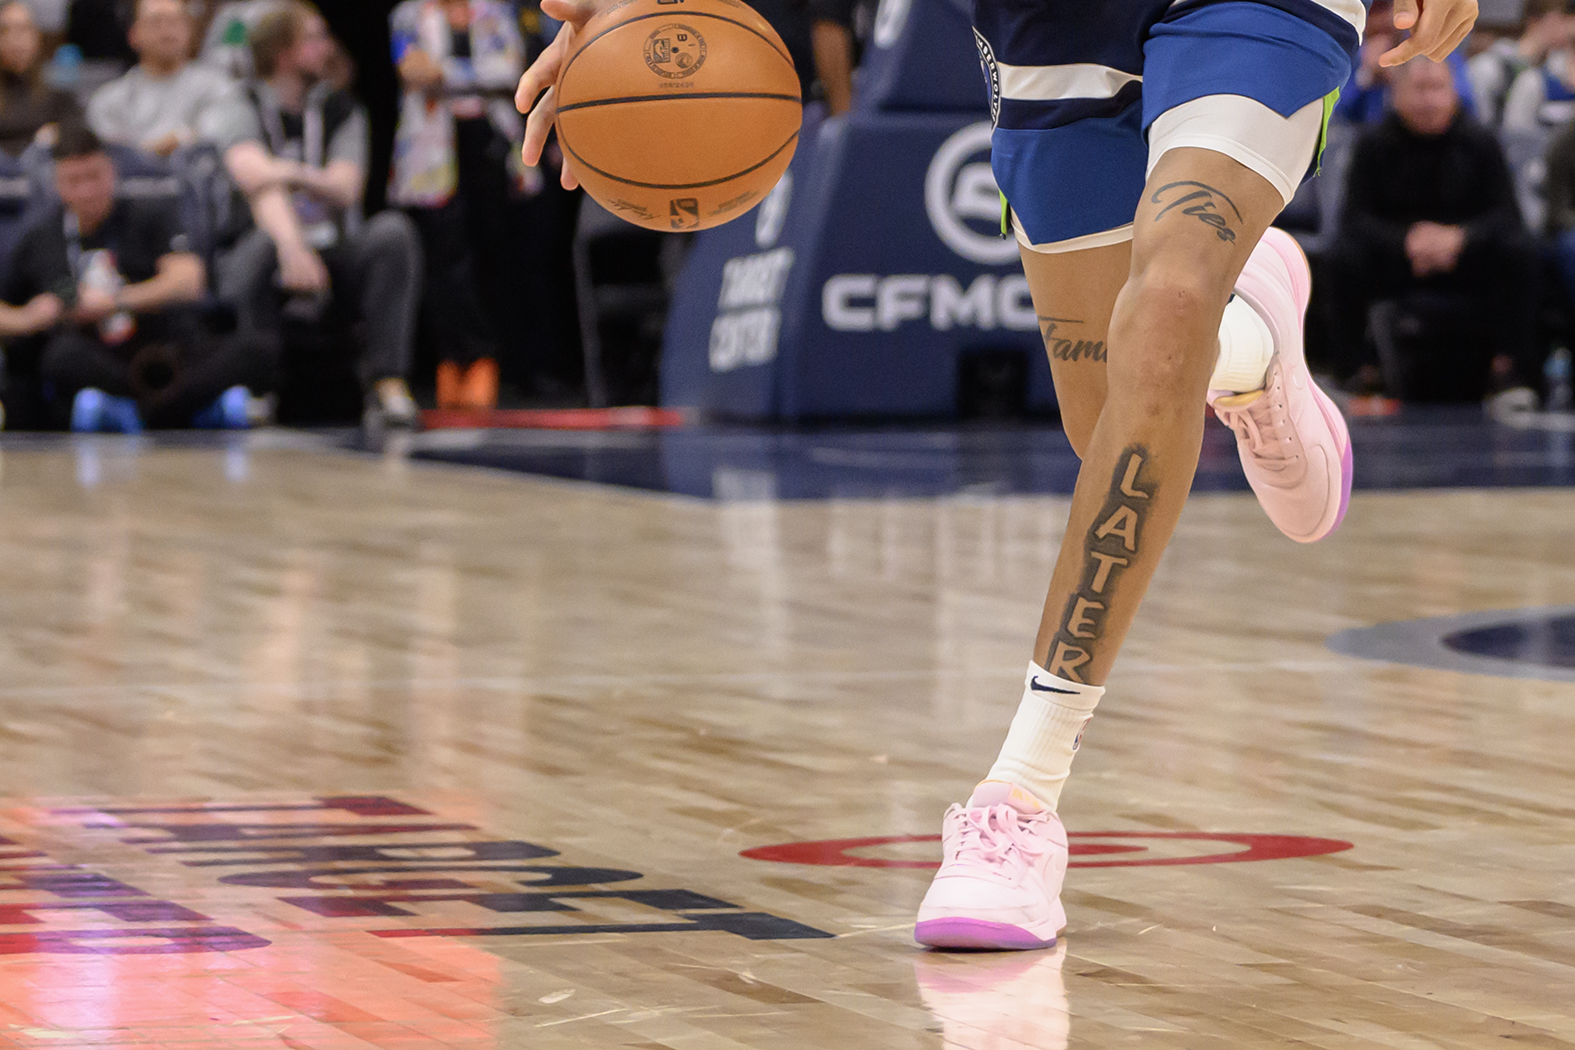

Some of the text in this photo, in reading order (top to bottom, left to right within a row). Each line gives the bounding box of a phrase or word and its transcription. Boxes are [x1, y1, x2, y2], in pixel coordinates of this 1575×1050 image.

[1151, 180, 1243, 245] Ties
[1048, 450, 1150, 685] LATER
[50, 794, 836, 940] TARGET
